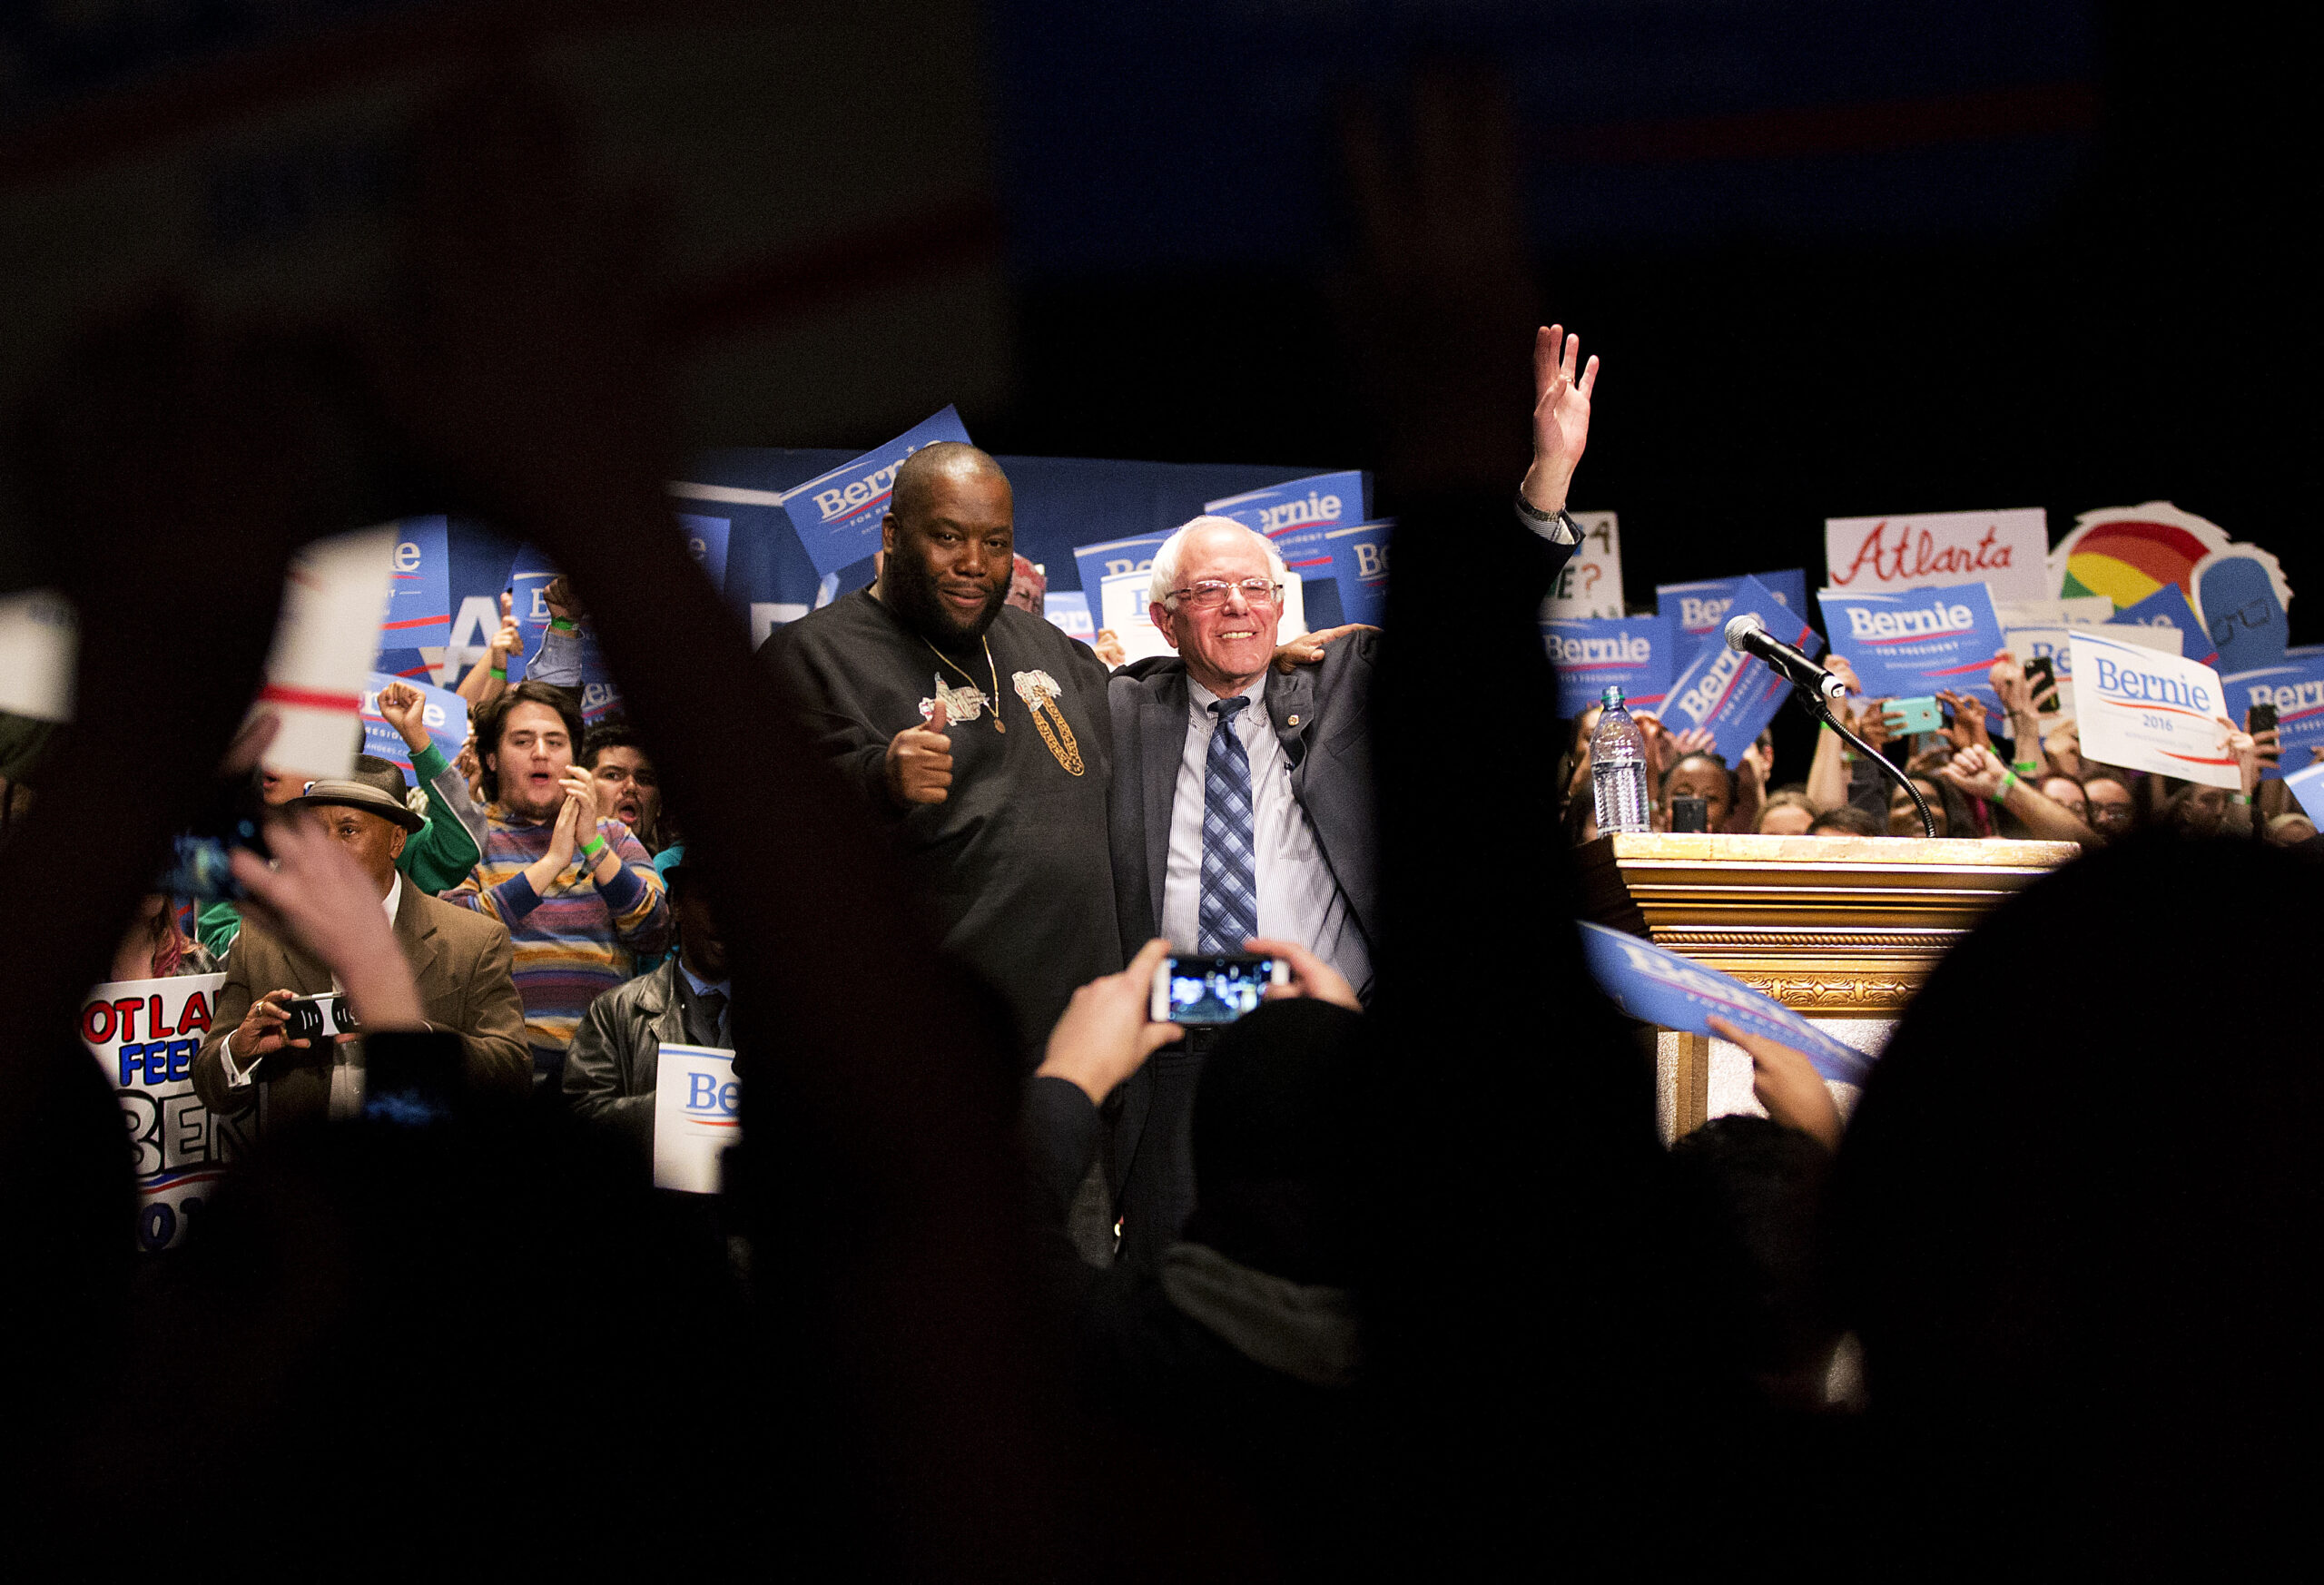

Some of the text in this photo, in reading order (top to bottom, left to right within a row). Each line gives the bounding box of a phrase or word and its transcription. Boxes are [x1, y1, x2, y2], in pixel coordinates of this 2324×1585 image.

[1829, 520, 2013, 586] Atlanta
[1846, 601, 1974, 636] Bernie
[1545, 633, 1650, 663] Bernie
[2095, 657, 2211, 712] Bernie
[2142, 714, 2173, 732] 2016
[81, 990, 219, 1044] OTLA
